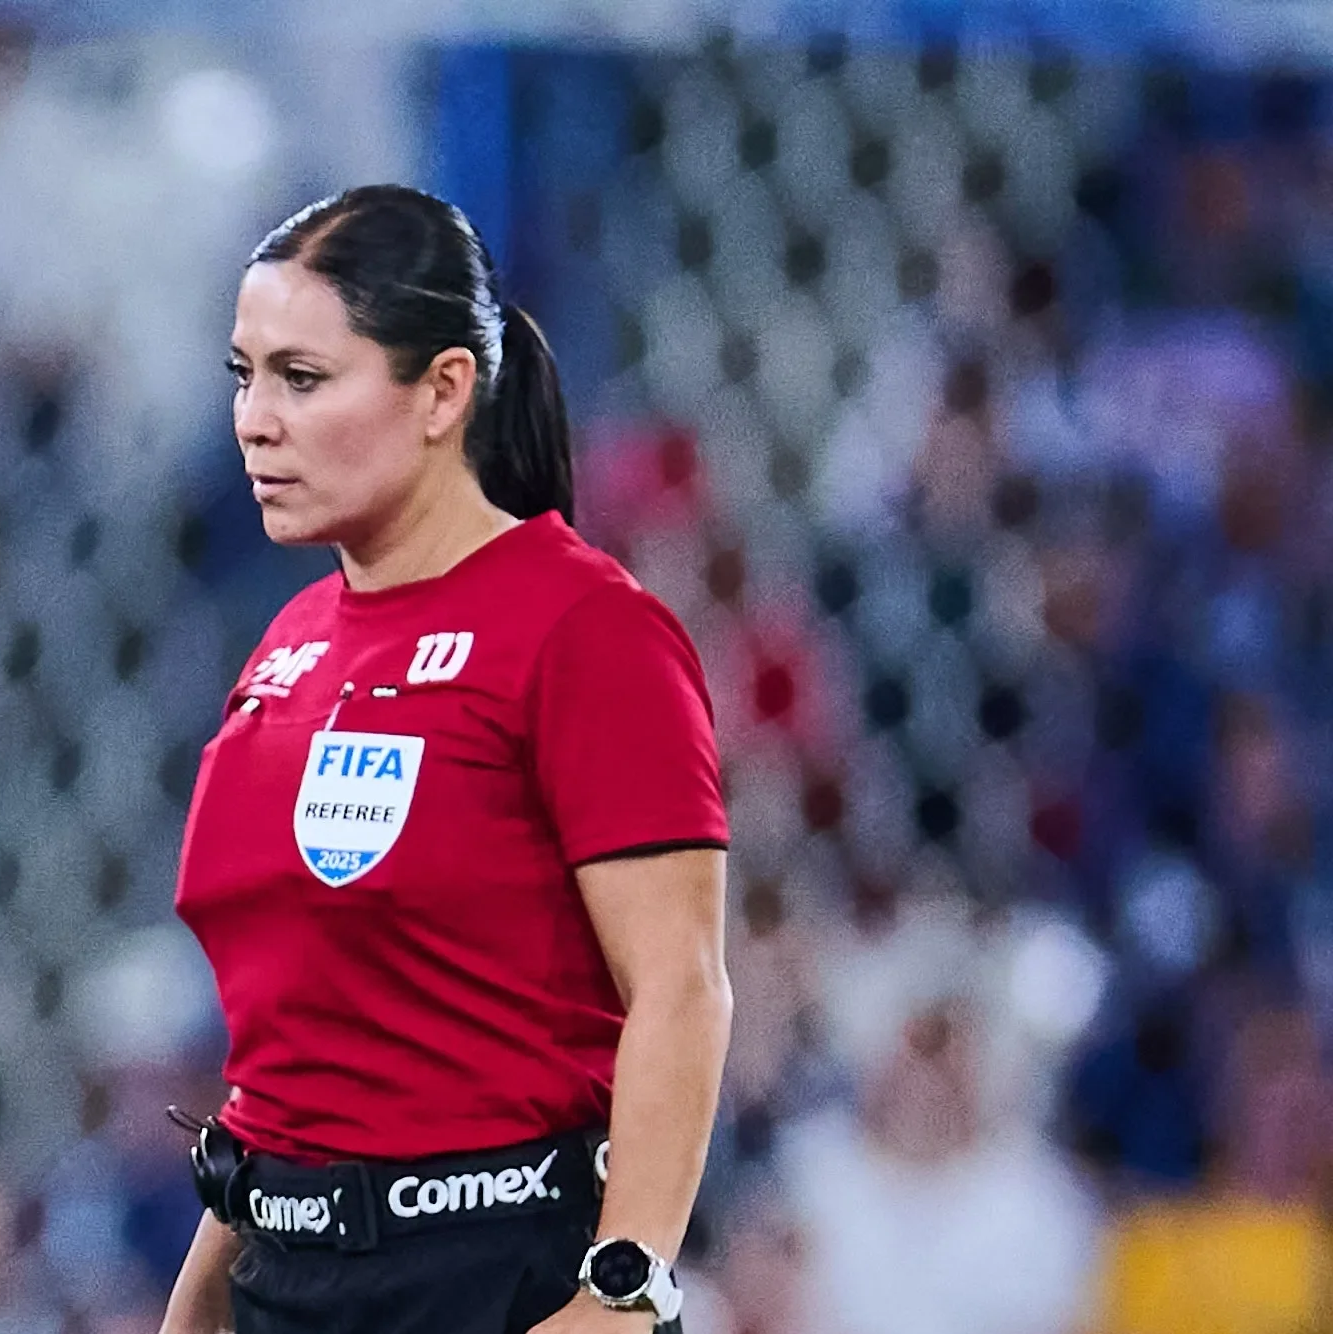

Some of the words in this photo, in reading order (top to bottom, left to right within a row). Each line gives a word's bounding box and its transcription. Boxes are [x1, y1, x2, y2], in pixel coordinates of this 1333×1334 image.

[316, 743, 404, 781] FIFA
[304, 802, 396, 824] REFEREE
[316, 850, 362, 871] 2025
